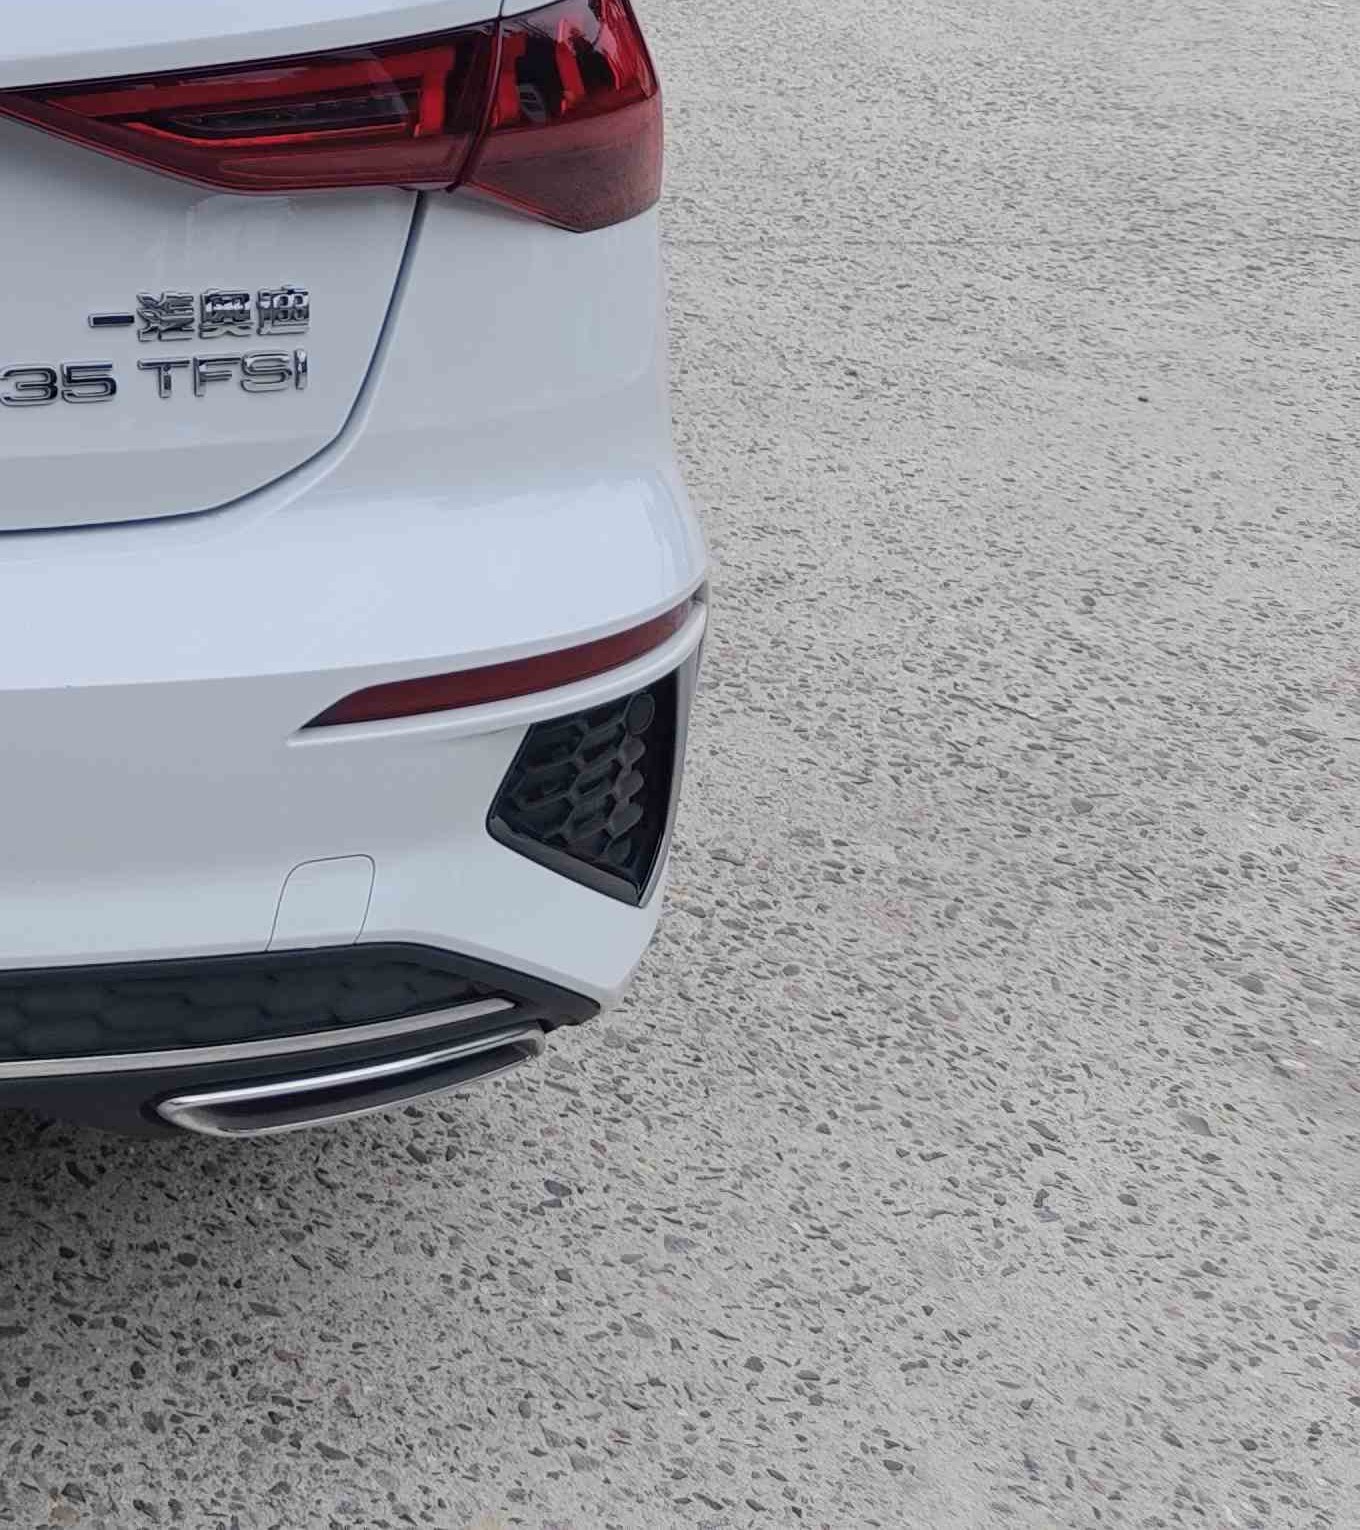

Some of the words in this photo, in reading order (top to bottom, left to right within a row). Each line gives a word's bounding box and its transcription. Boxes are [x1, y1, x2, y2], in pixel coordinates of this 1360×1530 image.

[88, 284, 310, 343] 一汽奥迪
[136, 347, 309, 400] TFSI
